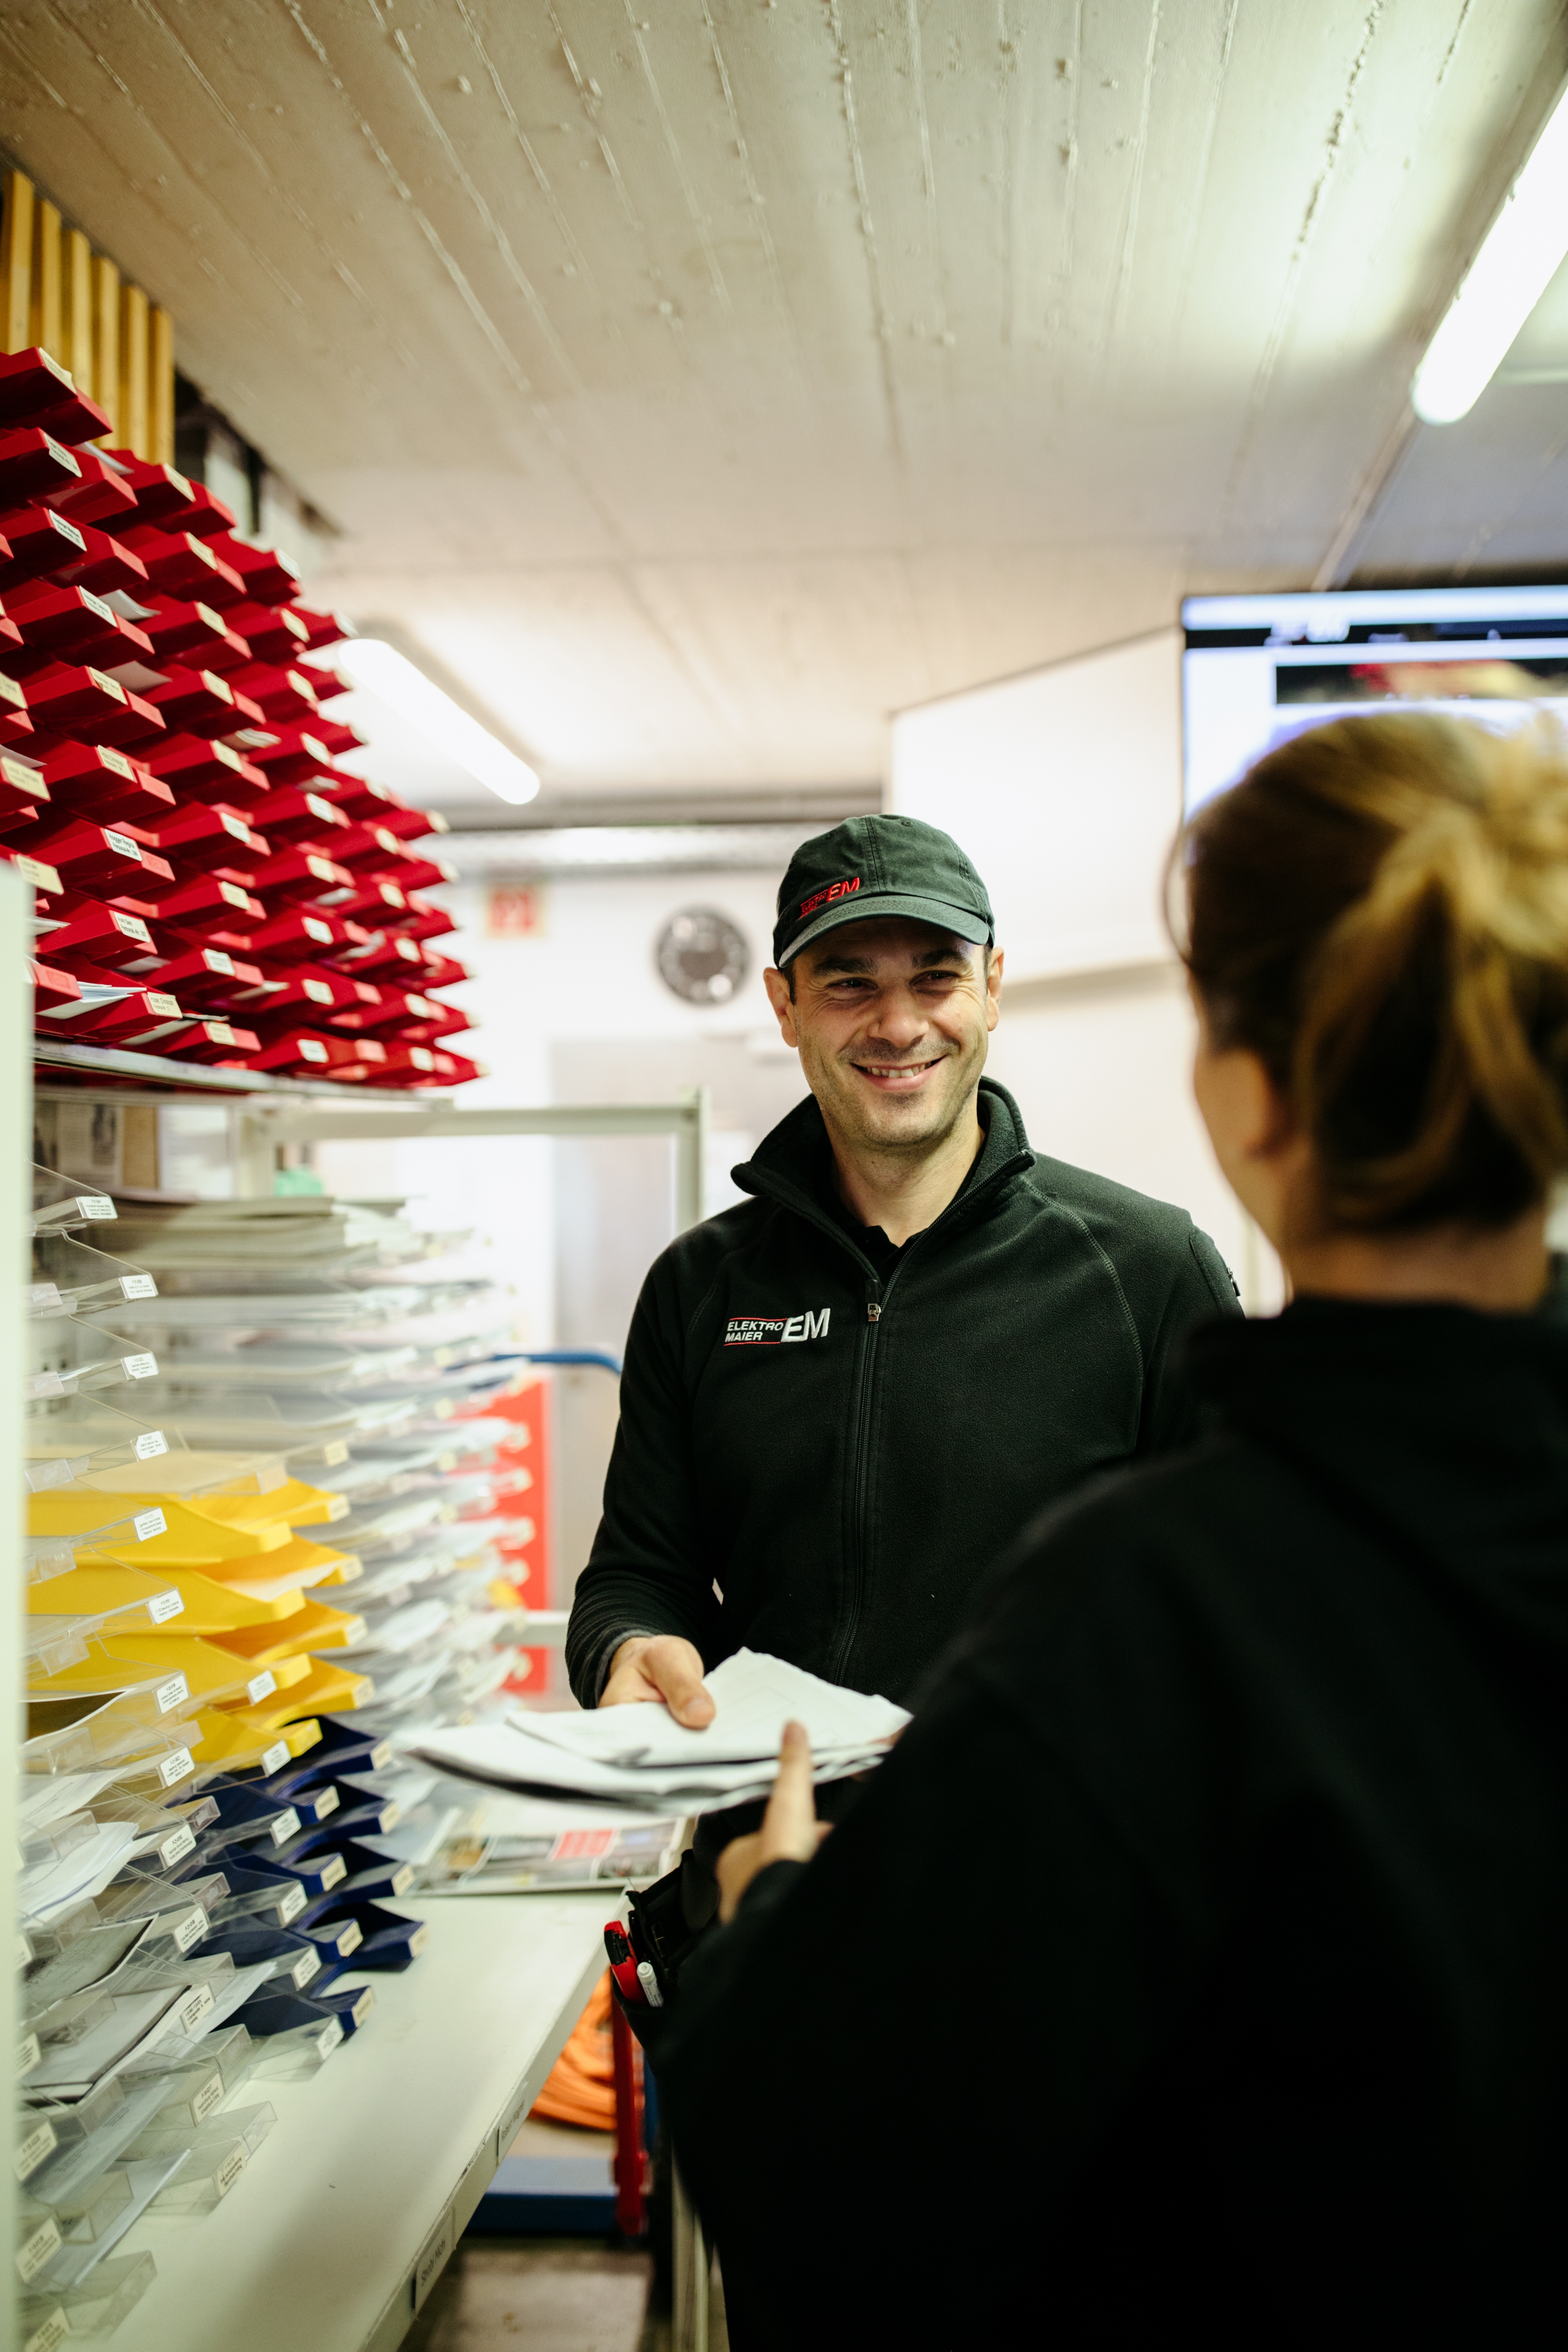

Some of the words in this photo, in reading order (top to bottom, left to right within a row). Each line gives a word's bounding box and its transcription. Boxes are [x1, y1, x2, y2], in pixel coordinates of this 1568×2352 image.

[826, 877, 860, 902] EM
[727, 1321, 783, 1331] ELEKTRO
[781, 1308, 831, 1343] EM
[725, 1331, 763, 1343] MAIER
